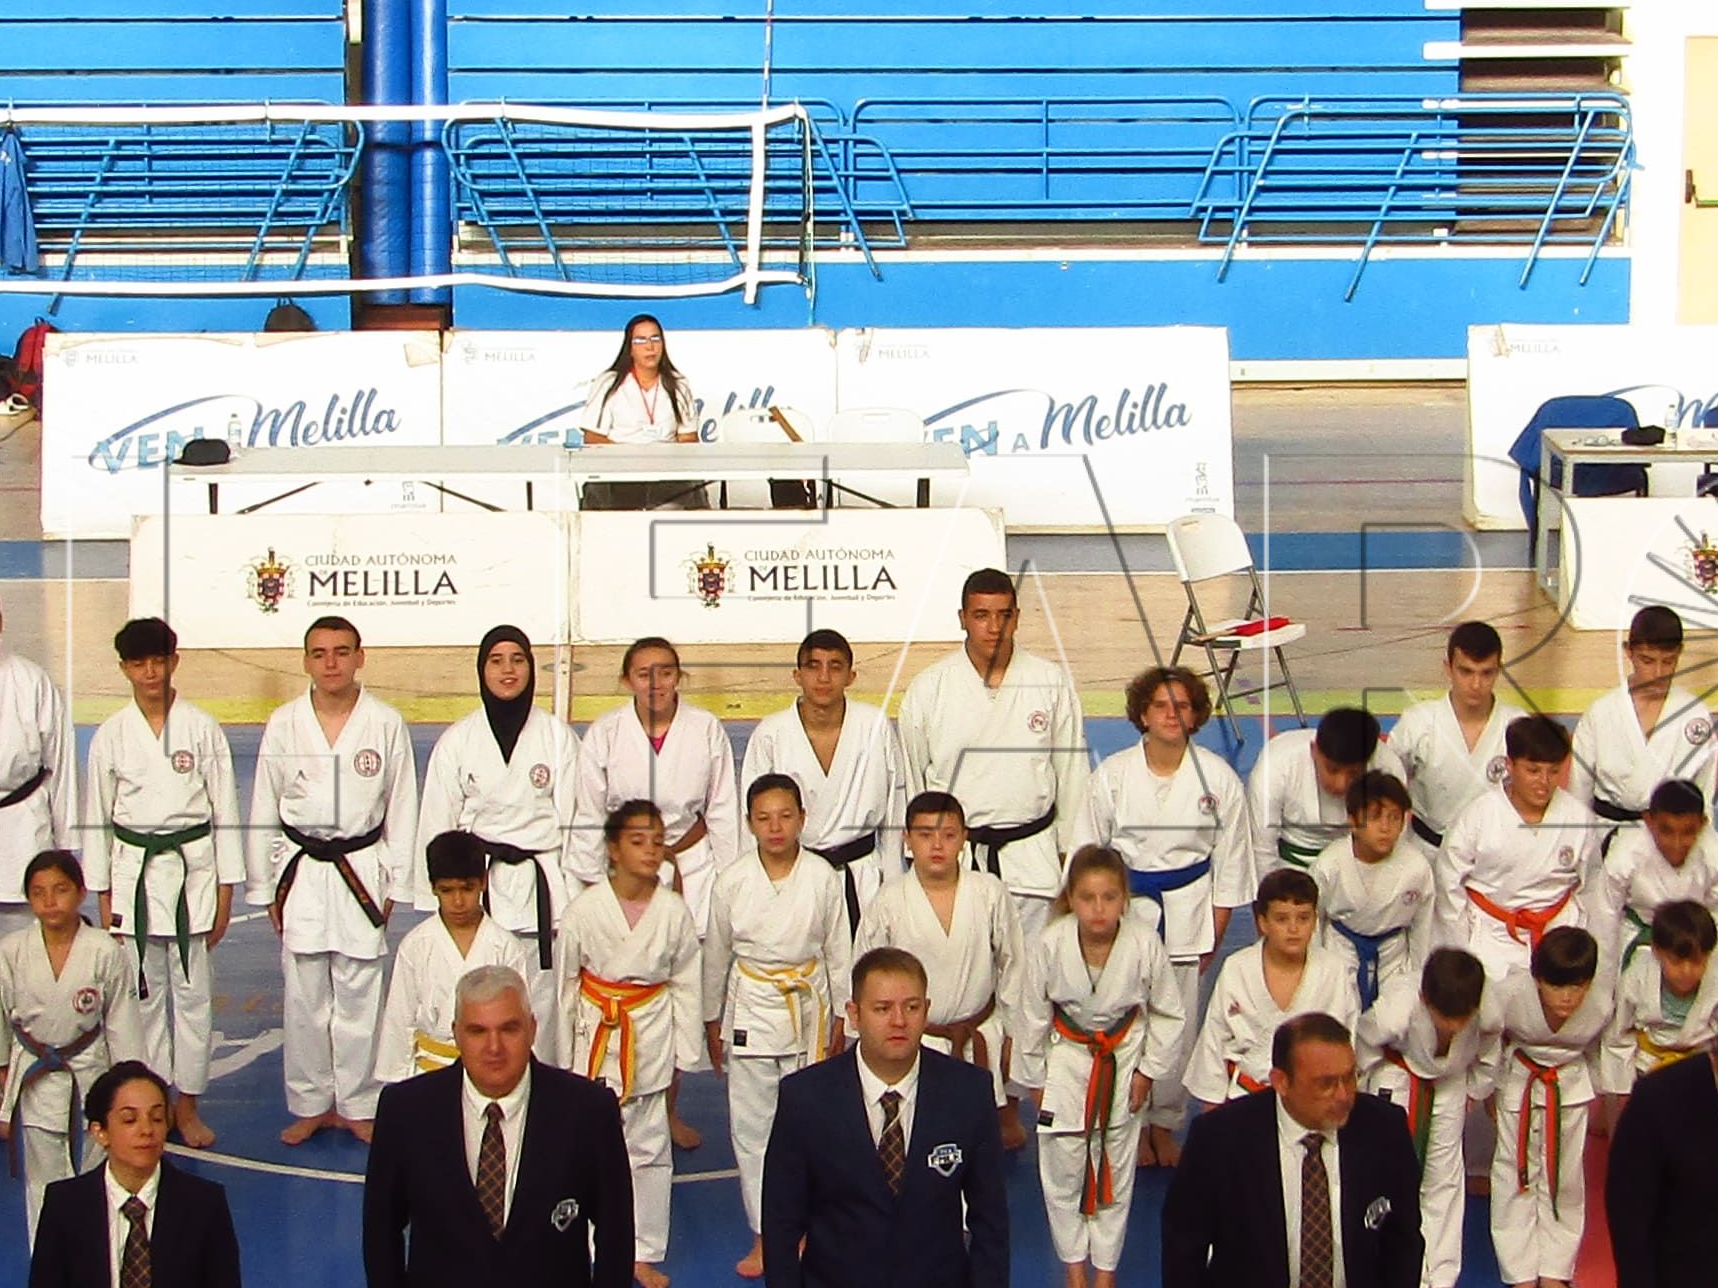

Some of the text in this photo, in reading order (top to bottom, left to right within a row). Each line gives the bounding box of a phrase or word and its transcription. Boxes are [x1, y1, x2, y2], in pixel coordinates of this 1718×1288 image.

[249, 387, 402, 448] Melilla
[1040, 382, 1192, 450] Melilla
[305, 552, 458, 566] CIUDAD AUTÓNOMA
[744, 547, 895, 562] CIUDAD AUTÓNOMA
[308, 570, 459, 597] MELILLA
[748, 564, 898, 591] MELILLA
